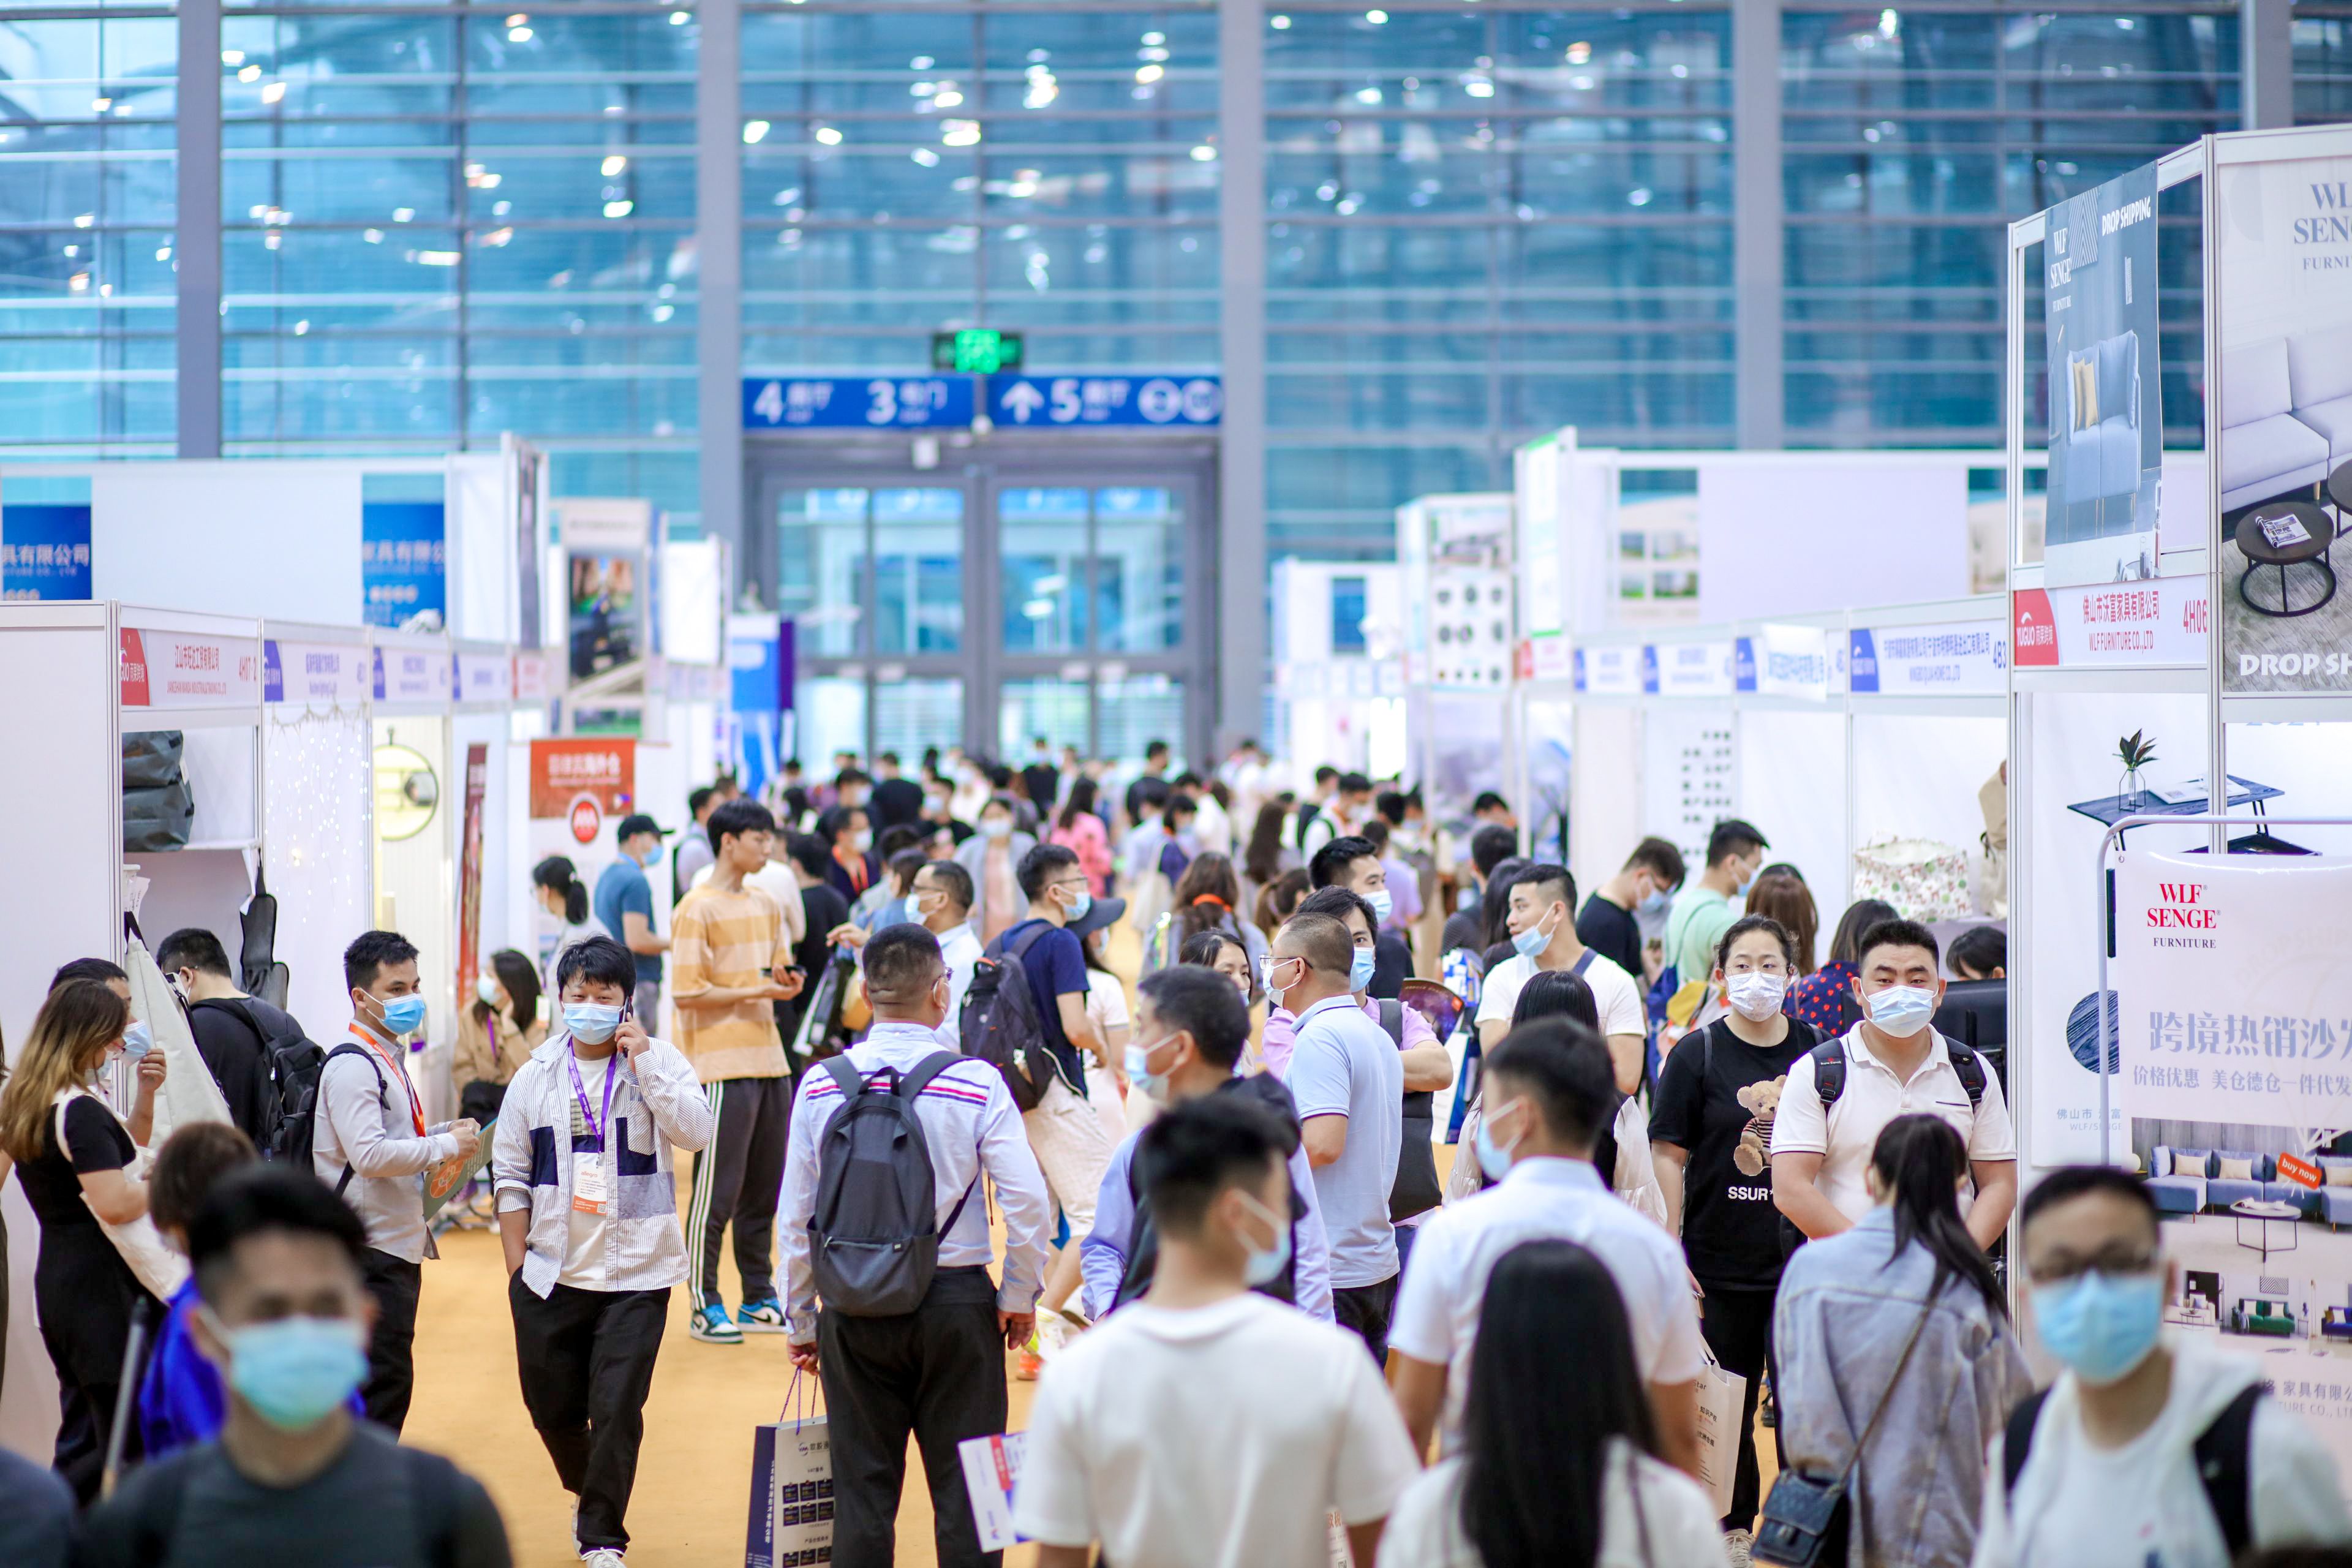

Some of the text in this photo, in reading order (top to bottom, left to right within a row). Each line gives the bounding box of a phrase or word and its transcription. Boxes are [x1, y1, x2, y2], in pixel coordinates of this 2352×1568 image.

[2102, 195, 2150, 236] DROP SHIPPING
[2294, 216, 2352, 244] SEN
[2051, 258, 2071, 289] SENGE
[2303, 255, 2352, 270] FURNI
[2053, 295, 2071, 312] FURNITURE
[753, 380, 783, 424] 4
[866, 380, 897, 424] 3
[1049, 379, 1082, 423] 5
[2083, 591, 2159, 624] 佛山市沃富家具有限公司
[2184, 599, 2207, 633] 4H06
[2089, 633, 2099, 651] WLF
[2101, 631, 2132, 650] FURNITURE
[2240, 654, 2320, 676] DROP
[2159, 883, 2202, 904] WLF
[2147, 908, 2217, 929] SENGE
[2153, 937, 2217, 949] FURNITURE
[2133, 1065, 2200, 1089] 价格优惠
[2282, 1158, 2317, 1182] buy now
